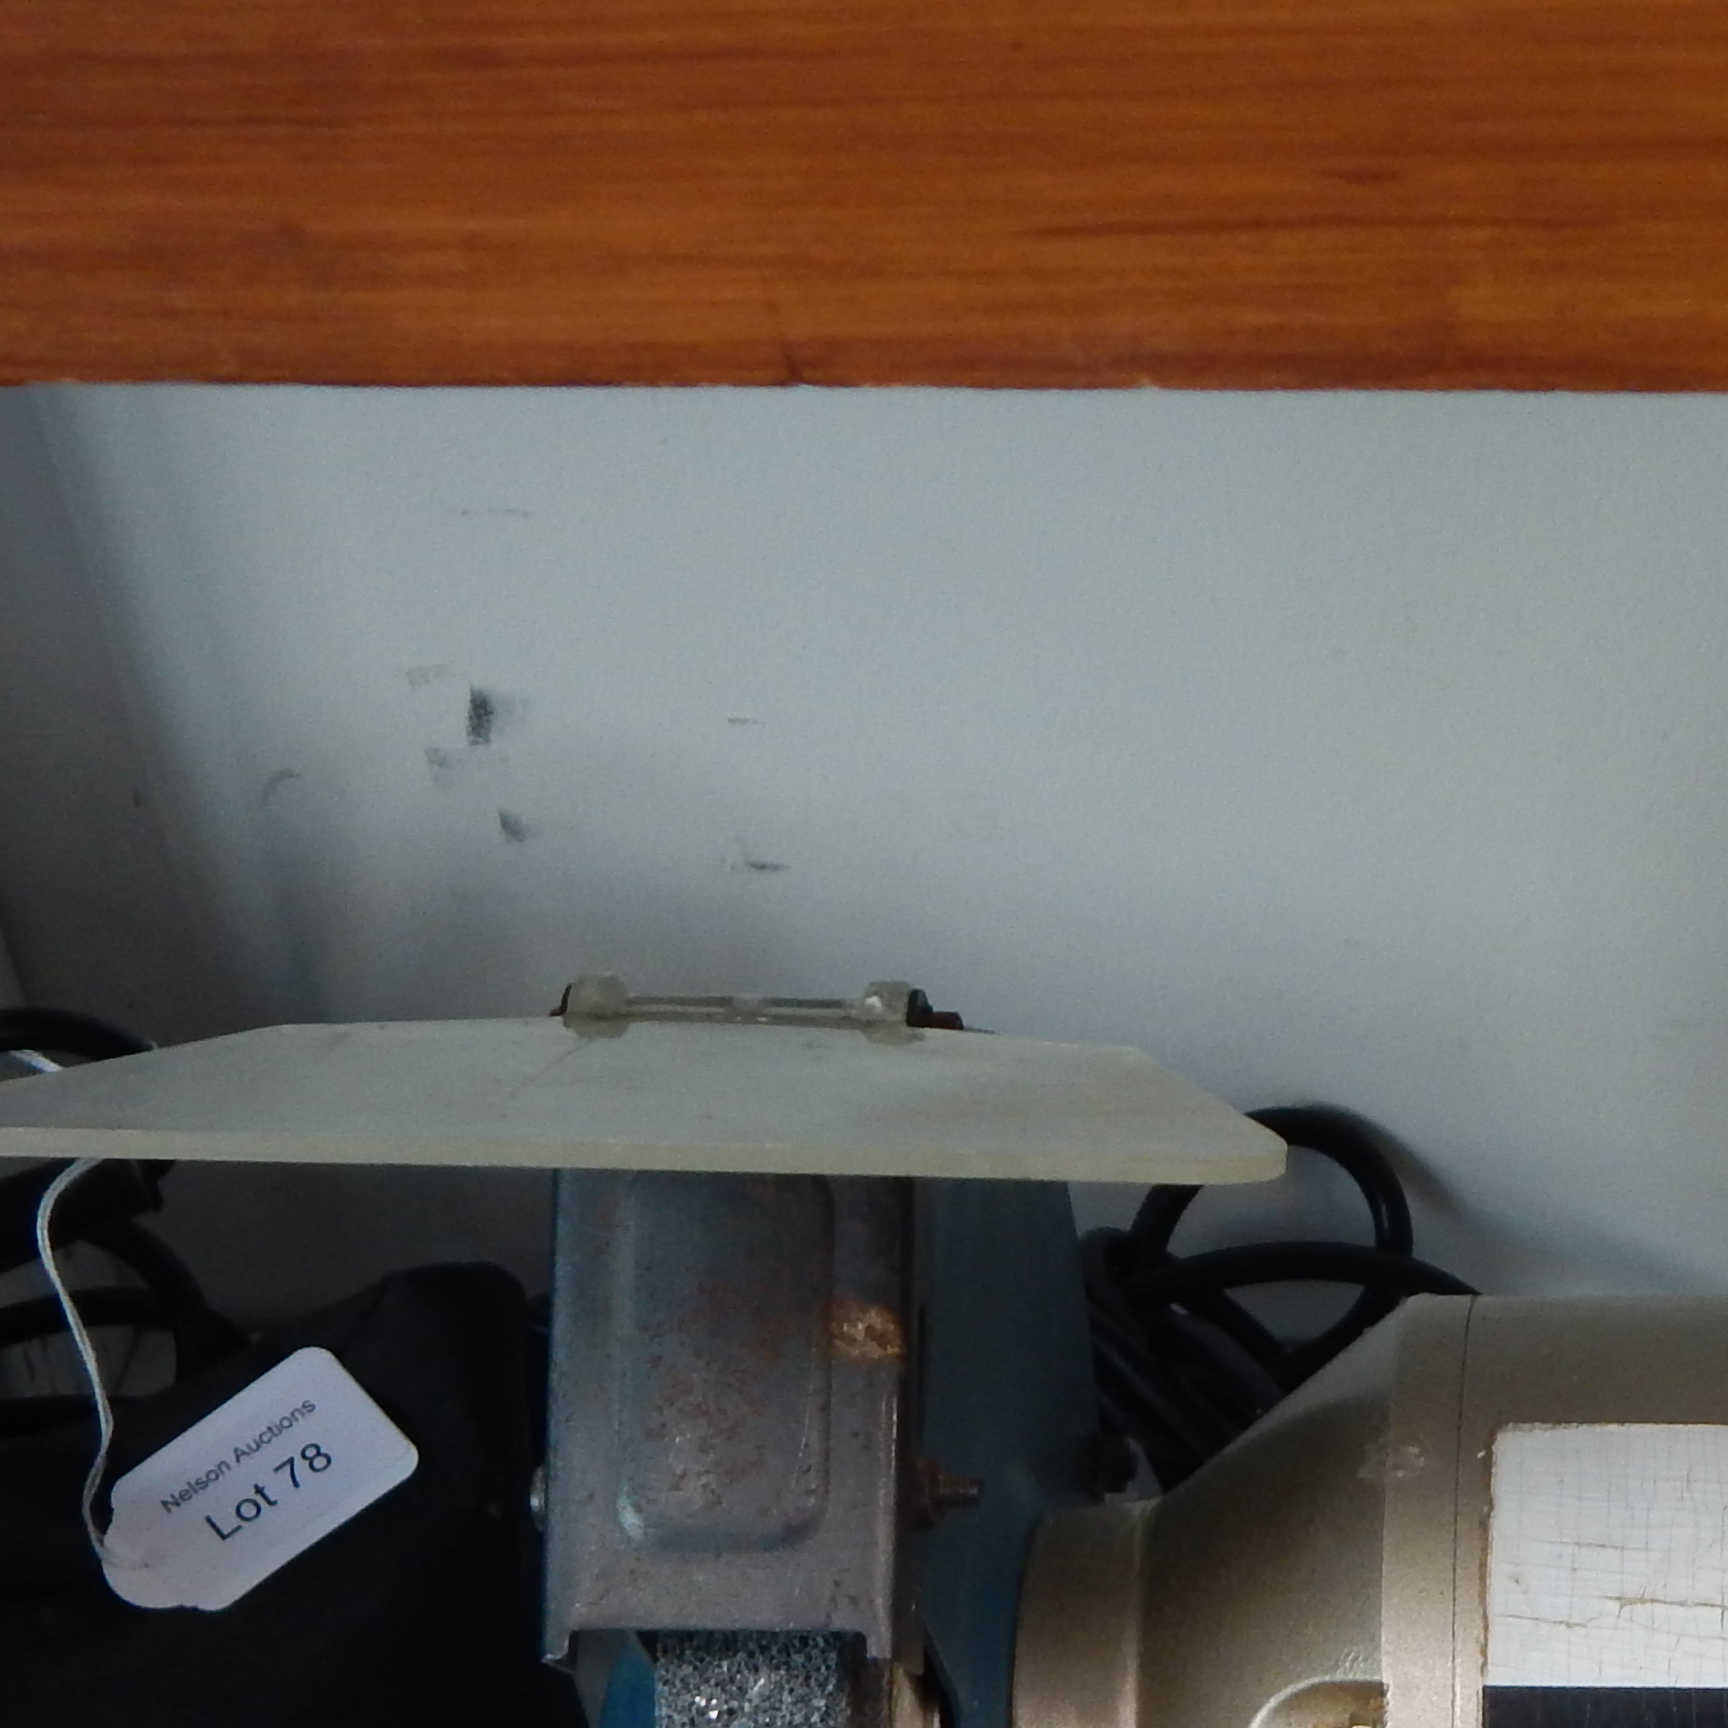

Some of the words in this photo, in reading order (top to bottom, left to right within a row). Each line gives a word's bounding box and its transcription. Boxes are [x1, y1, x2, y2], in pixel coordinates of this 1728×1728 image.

[159, 1458, 232, 1515] Nelson
[233, 1399, 316, 1464] Auctions
[205, 1483, 279, 1542] Lot
[273, 1442, 332, 1489] 78
